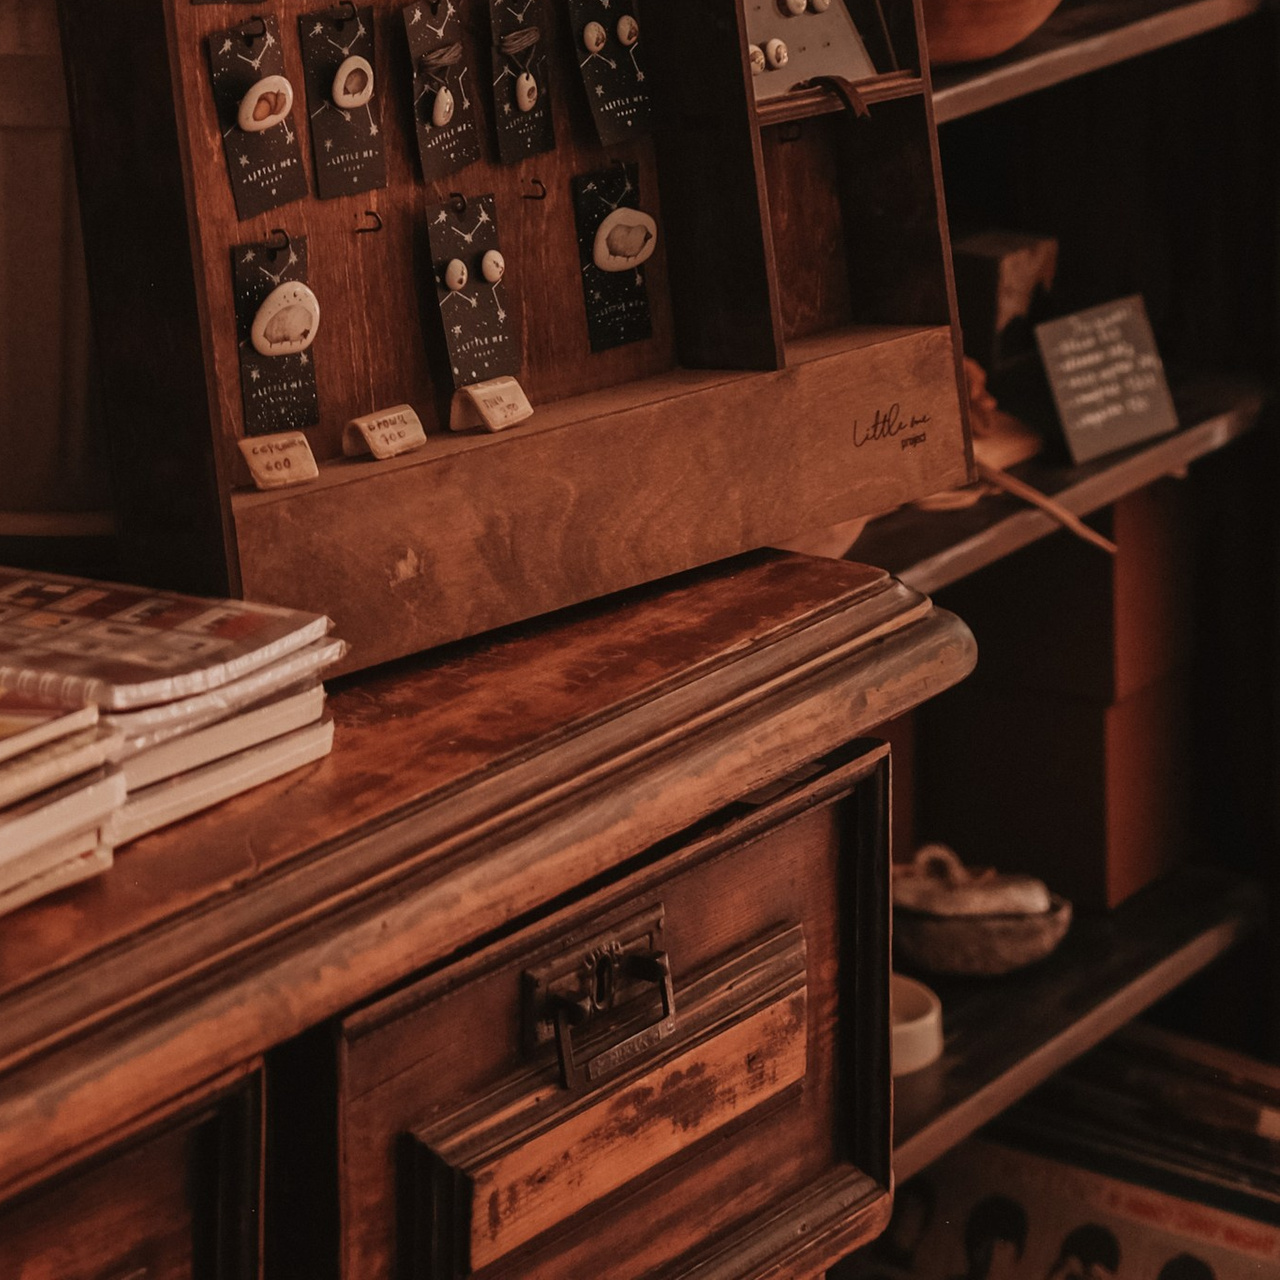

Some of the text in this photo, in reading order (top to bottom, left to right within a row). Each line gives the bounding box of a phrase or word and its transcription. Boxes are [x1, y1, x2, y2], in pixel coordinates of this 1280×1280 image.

[332, 152, 359, 166] LITTLE
[248, 163, 276, 182] LITTLE
[853, 403, 908, 447] Little
